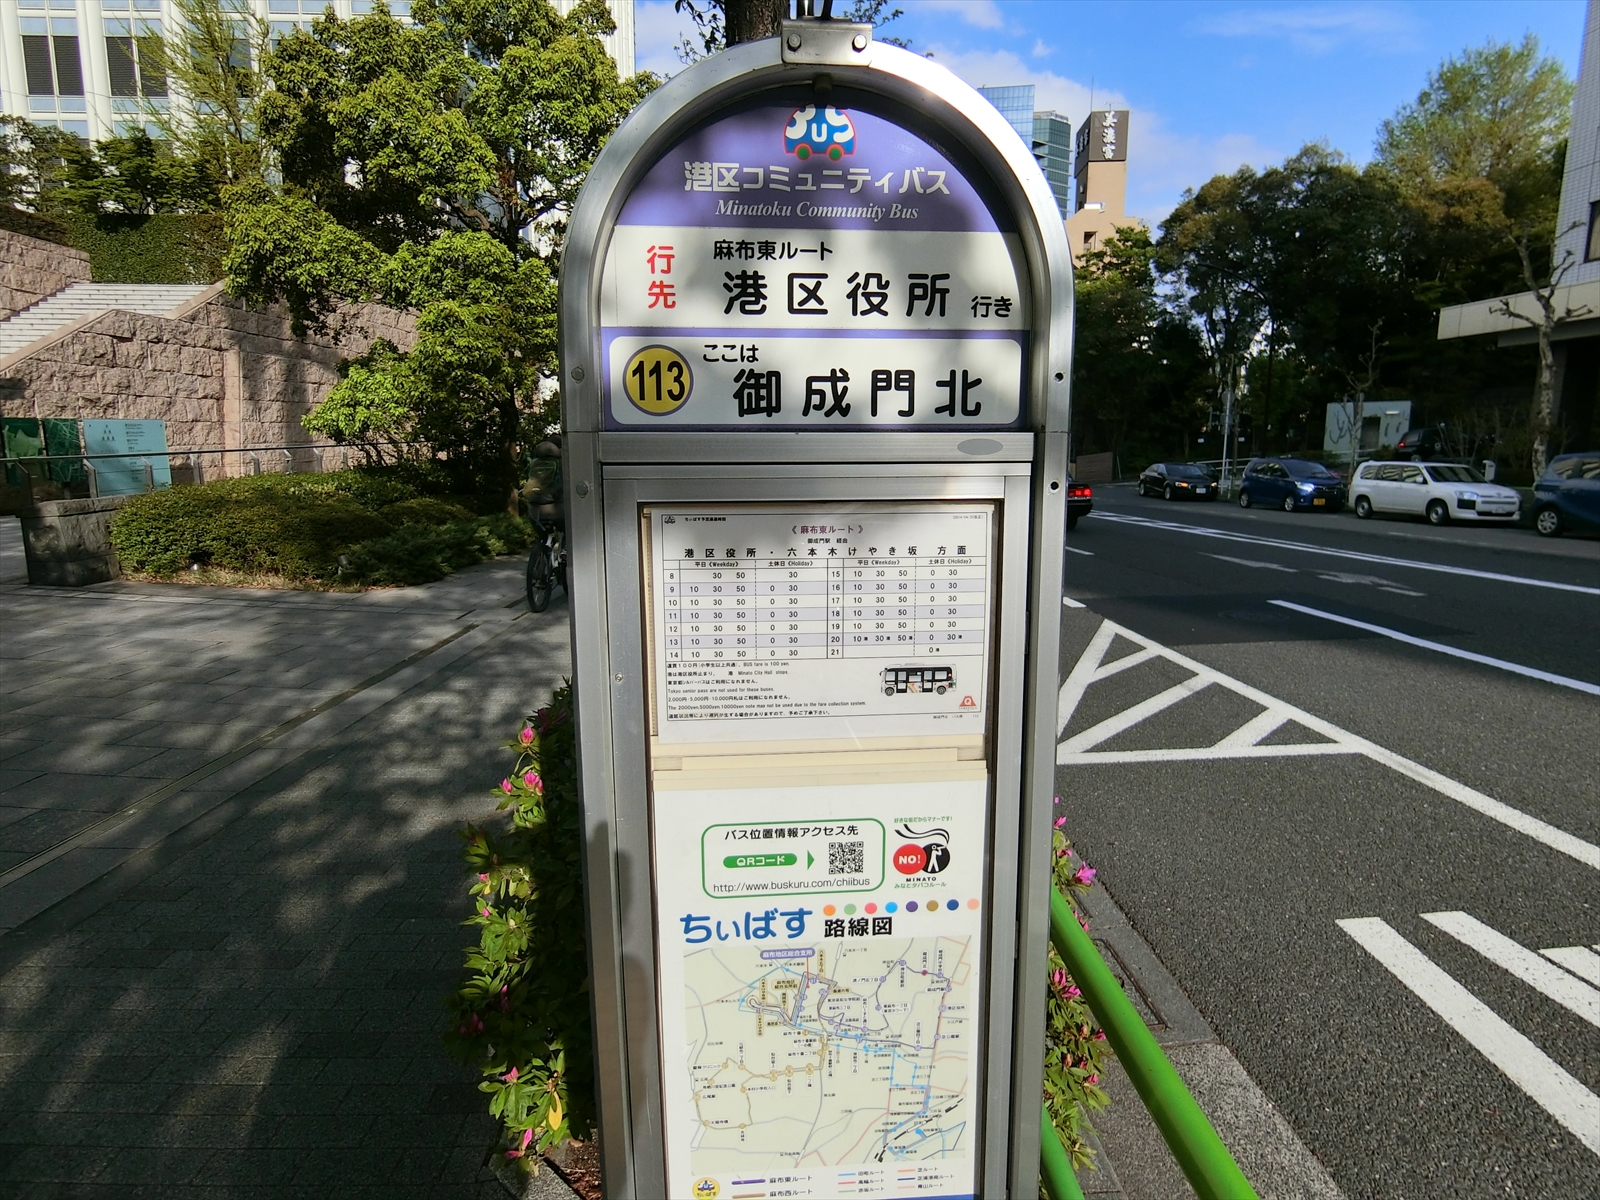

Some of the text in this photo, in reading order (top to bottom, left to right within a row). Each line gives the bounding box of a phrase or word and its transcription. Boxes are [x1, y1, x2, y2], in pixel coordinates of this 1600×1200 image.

[684, 162, 951, 195] 港区コミュニティバス
[715, 199, 918, 222] Minatoku Community Bus
[713, 240, 833, 261] 麻布東ルート
[647, 245, 677, 309] 行先
[722, 271, 1013, 318] 港区役所 行き
[703, 344, 759, 363] ここは
[632, 360, 686, 402] 113
[733, 368, 983, 418] 御成門北
[725, 825, 859, 840] バス位置情報アクセス先
[736, 855, 785, 866] QRコード
[713, 877, 870, 893] http://www.buskuru.com/chiibus
[824, 917, 892, 938] 路線図
